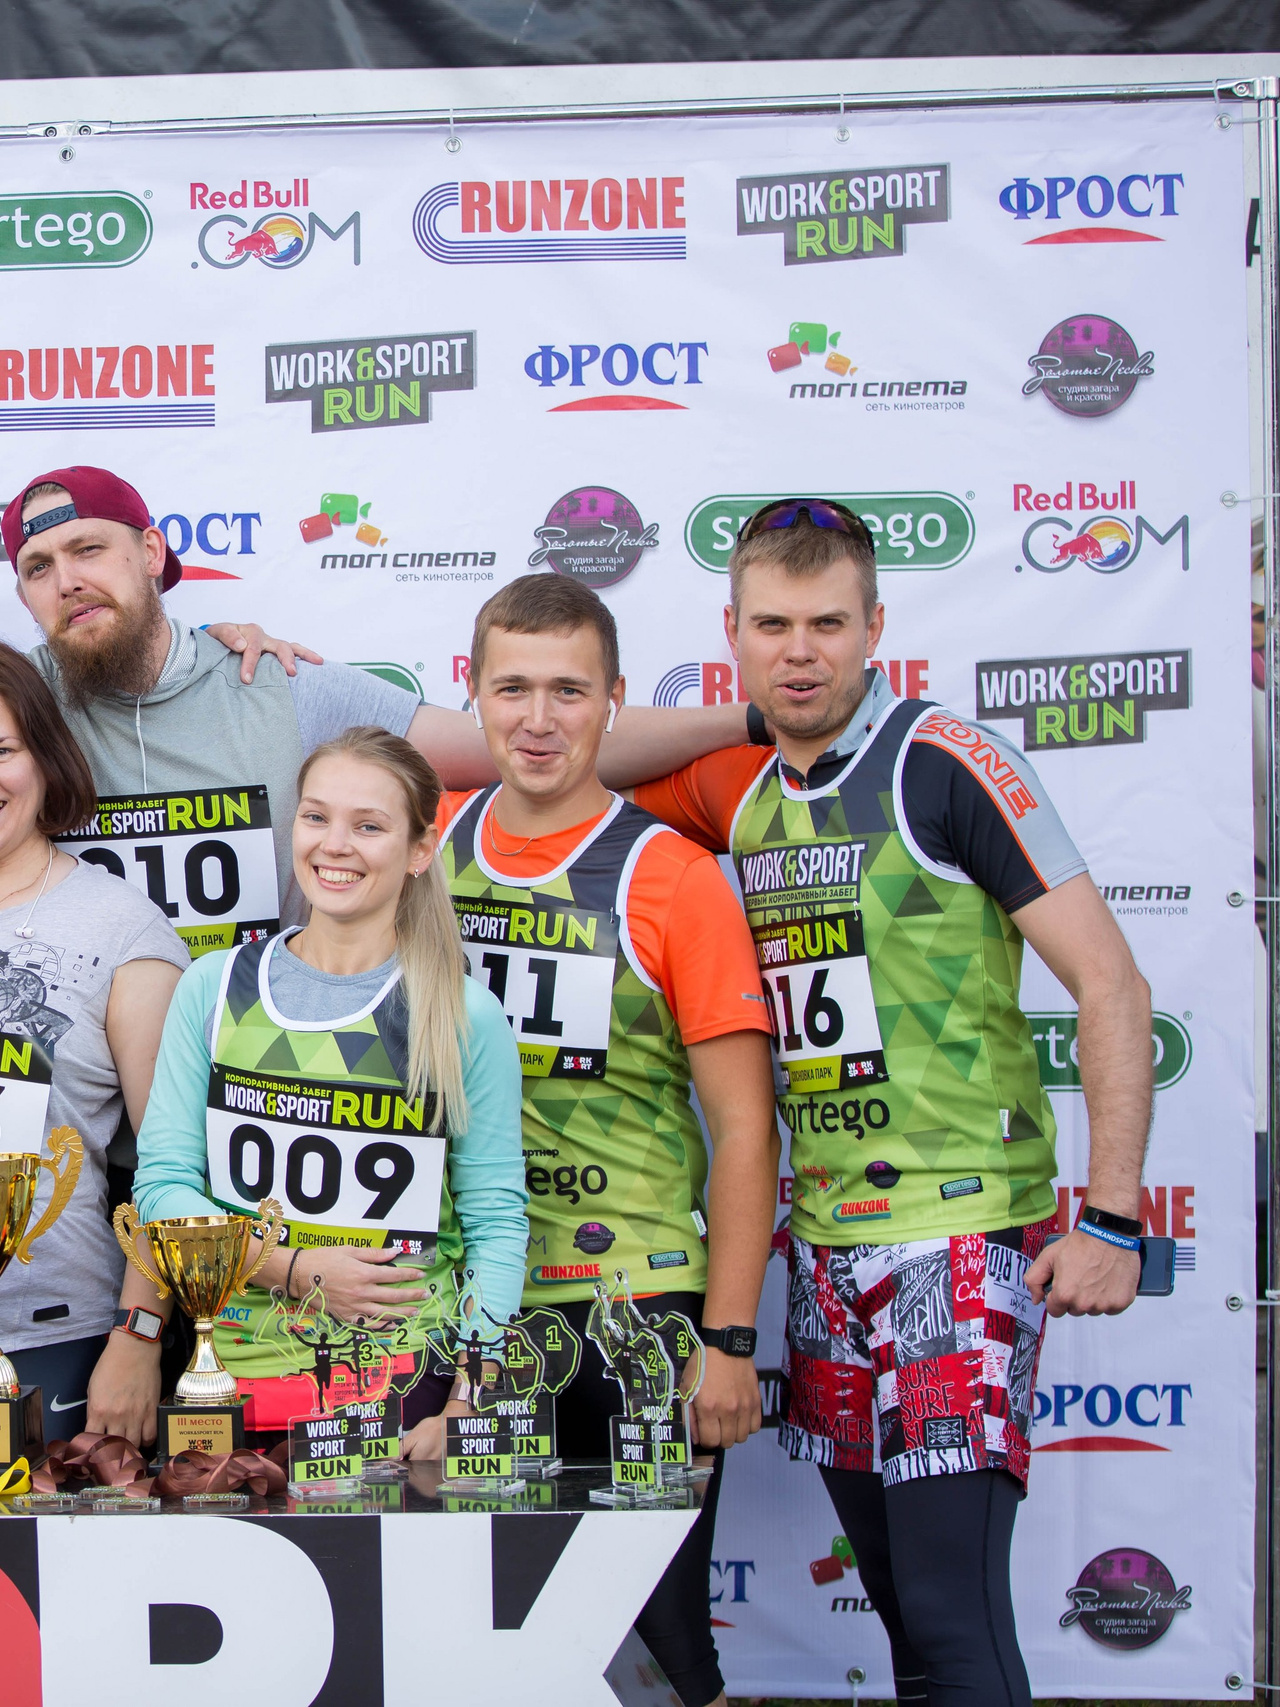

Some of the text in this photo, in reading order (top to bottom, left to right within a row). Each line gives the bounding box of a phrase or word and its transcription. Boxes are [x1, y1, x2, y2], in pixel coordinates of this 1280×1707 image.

[190, 178, 309, 209] Red Bull
[742, 171, 941, 223] WORK&SPORT
[999, 173, 1185, 220] ФРОСТ
[461, 177, 686, 233] RUNZONE
[796, 213, 895, 258] RUN
[270, 338, 468, 391] WORK&SPORT
[523, 342, 709, 388] ФРОСТ
[790, 381, 967, 398] mori cinema
[1058, 385, 1119, 396] студия загара
[1074, 392, 1111, 402] красоты
[322, 380, 421, 426] RUN
[865, 400, 965, 412] сеть кинотеатров
[1013, 481, 1136, 511] Red Bull
[321, 551, 496, 569] mori cinema
[564, 556, 624, 566] студия загара
[580, 564, 616, 573] красоты
[396, 571, 493, 582] сеть кинотеатров
[981, 656, 1182, 708] WORK&SPORT
[1036, 700, 1135, 745] RUN
[136, 799, 164, 809] ЗАБЕГ
[167, 792, 251, 831] RUN
[743, 844, 865, 893] WORK&SPORT
[770, 888, 854, 903] КОРПОРАТИВНЫЙ ЗАБЕГ
[484, 905, 509, 915] ЗАБЕГ
[1117, 906, 1188, 917] кинотеатров
[508, 908, 597, 950] RUN
[771, 929, 786, 938] ЗАБЕГ
[201, 933, 224, 947] ПАРК
[787, 918, 848, 960] RUN
[520, 1053, 544, 1066] ПАРК
[792, 1066, 833, 1082] СОСНОВКА ПАРК
[225, 1072, 331, 1098] КОРПОРАТИВНЫЙ ЗАБЕГ
[225, 1083, 424, 1131] WORK&SPORT RUN
[229, 1123, 415, 1220] 009
[841, 1198, 890, 1216] RUNZONE
[297, 1231, 345, 1247] СОСНОВКА
[541, 1263, 602, 1279] RUNZONE
[397, 1328, 408, 1345] 2
[546, 1325, 559, 1344] 1
[677, 1332, 688, 1351] 3
[360, 1344, 373, 1361] 3
[509, 1342, 522, 1361] 1
[647, 1350, 658, 1370] 2
[900, 1382, 955, 1424] SURF
[189, 1418, 223, 1426] место
[306, 1419, 349, 1438] WORK&
[458, 1418, 499, 1434] WORK&
[619, 1424, 645, 1440] WORK&
[310, 1439, 345, 1459] SPORT
[462, 1438, 495, 1455] SPORT
[622, 1444, 643, 1460] SPORT
[306, 1459, 351, 1479] RUN
[458, 1459, 500, 1475] RUN
[621, 1464, 647, 1482] RUN
[1095, 1618, 1156, 1628] студия загара
[1111, 1626, 1148, 1635] красоты
